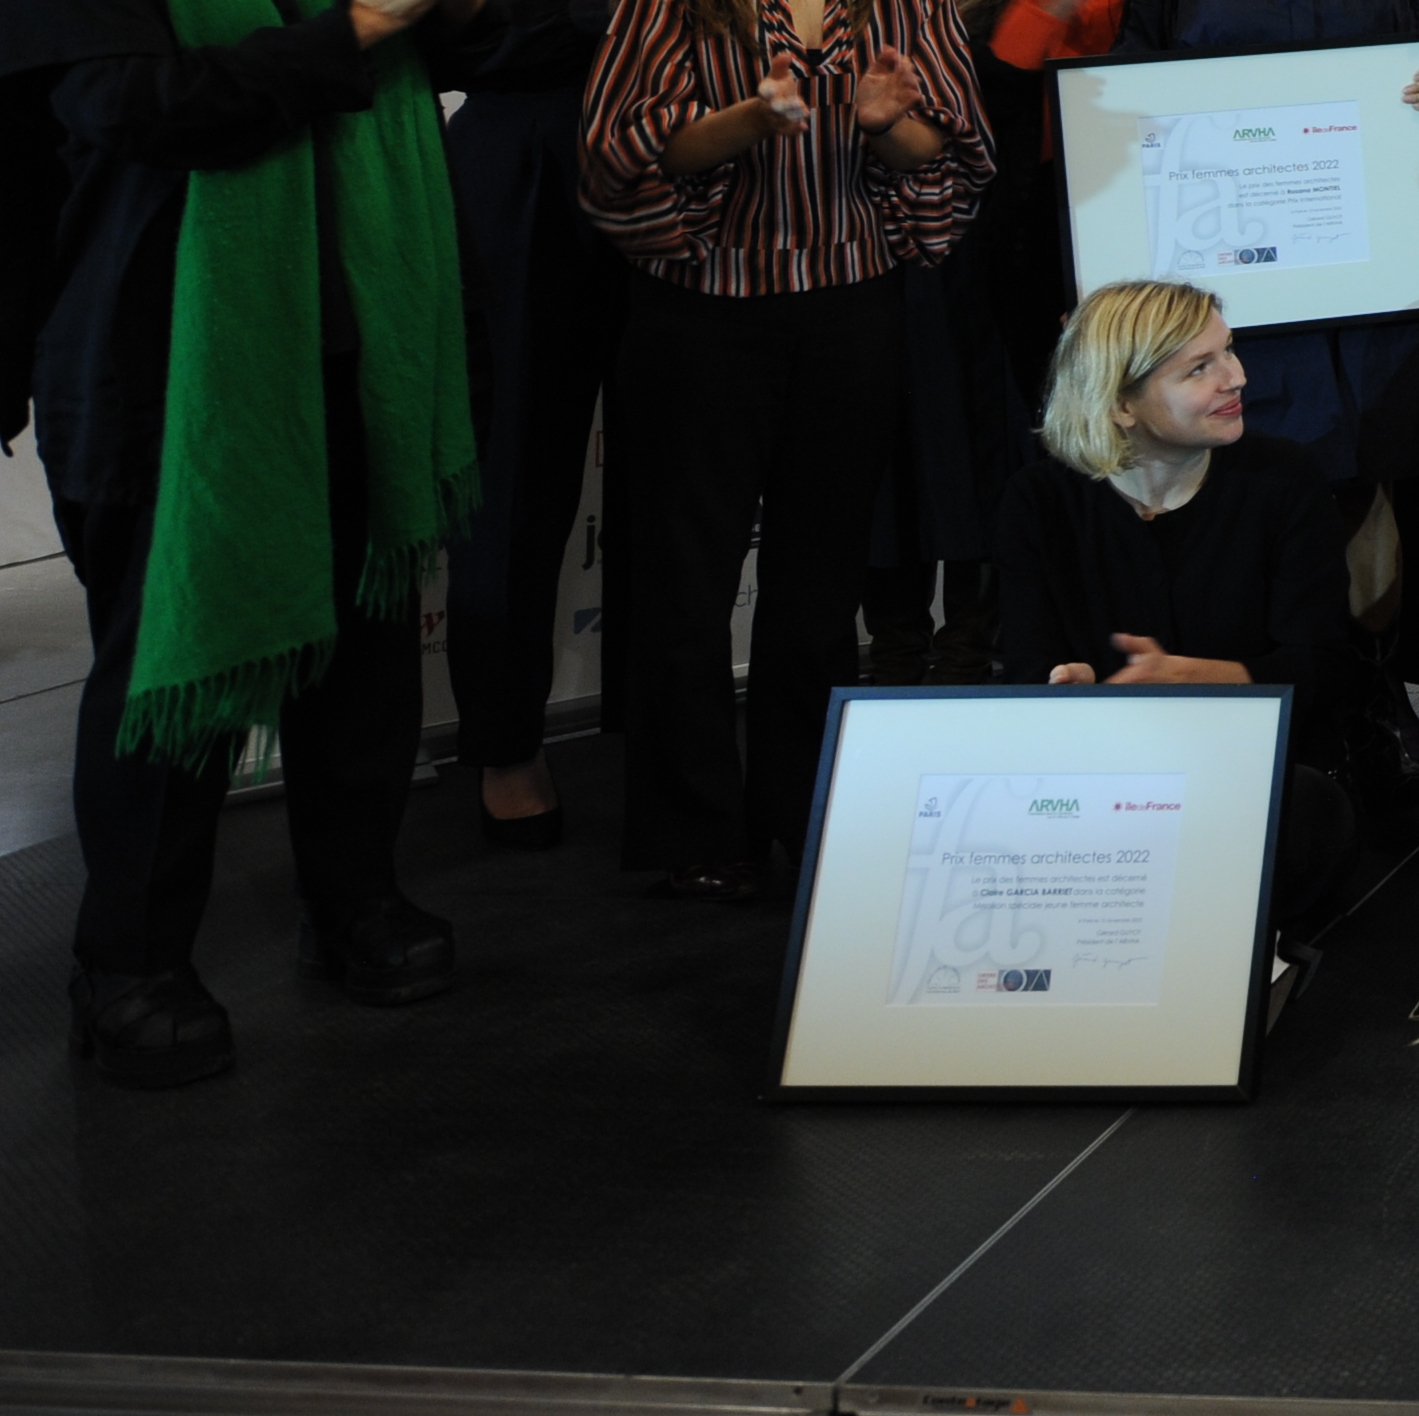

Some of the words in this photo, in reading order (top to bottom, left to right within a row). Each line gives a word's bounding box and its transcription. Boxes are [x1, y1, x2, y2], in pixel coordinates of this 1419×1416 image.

[1234, 127, 1275, 139] ARVHA
[1169, 171, 1189, 181] Prix
[1192, 168, 1239, 178] femmes
[1243, 162, 1309, 176] architectes
[1312, 159, 1339, 170] 2022
[1028, 799, 1080, 812] ARVHA
[942, 852, 967, 865] Prix
[969, 852, 1026, 865] femmes
[1031, 851, 1111, 864] architectes
[1116, 850, 1150, 863] 2022
[983, 876, 997, 884] prix
[1101, 900, 1144, 908] architecte
